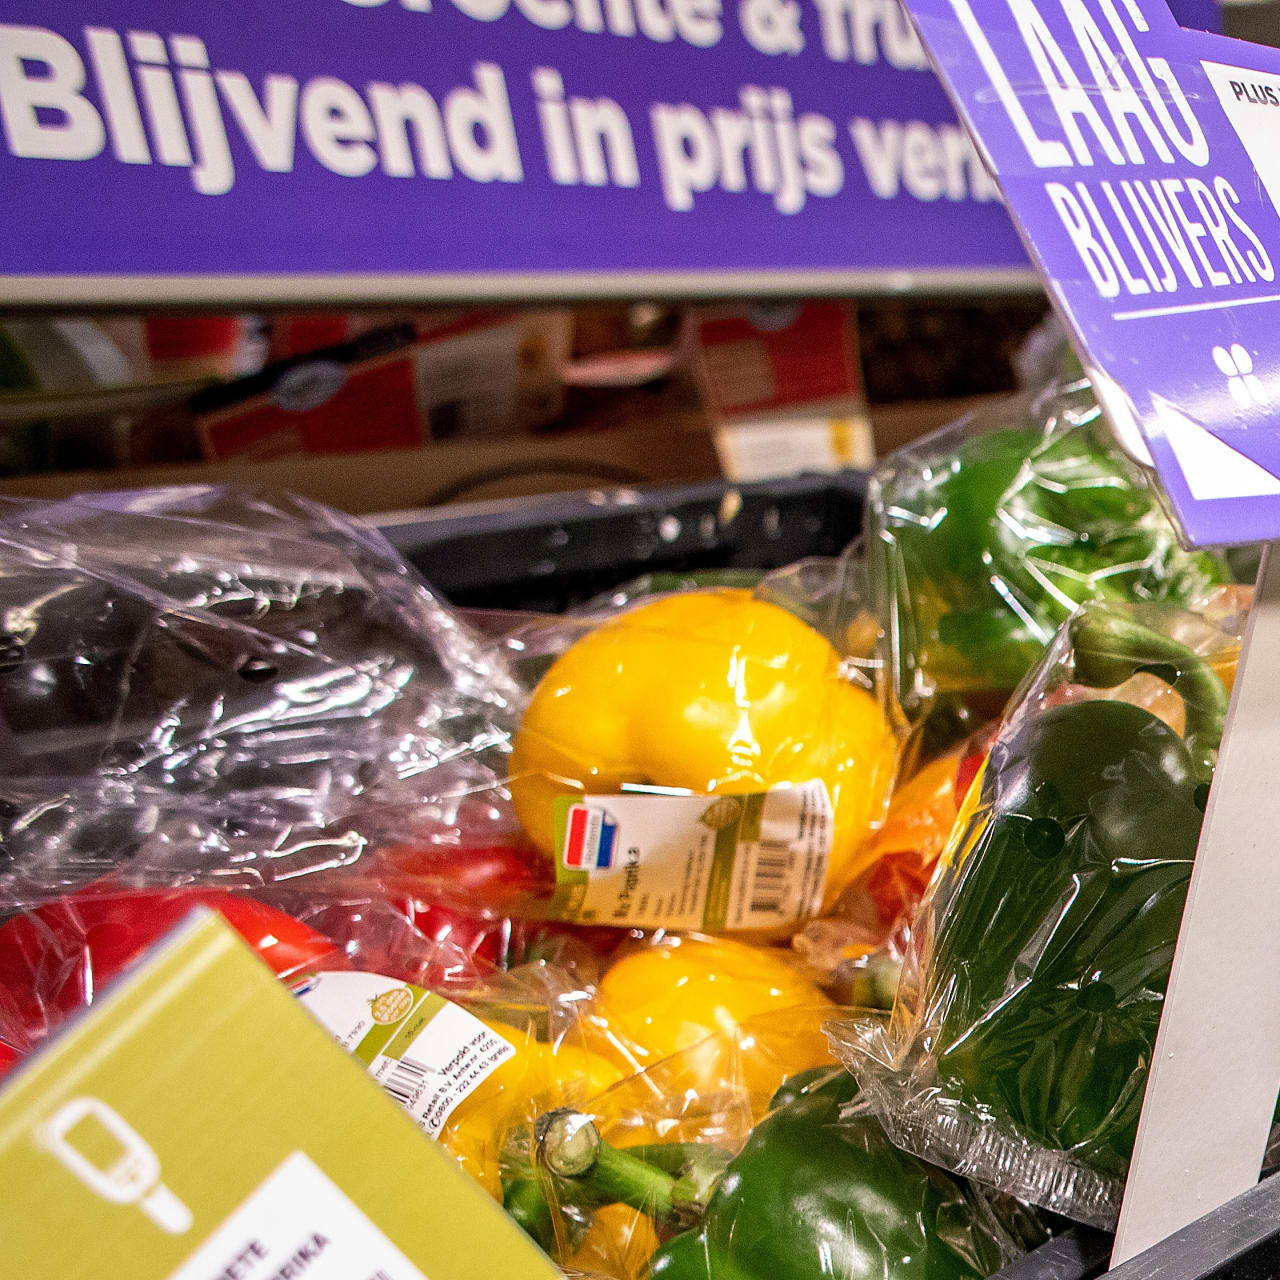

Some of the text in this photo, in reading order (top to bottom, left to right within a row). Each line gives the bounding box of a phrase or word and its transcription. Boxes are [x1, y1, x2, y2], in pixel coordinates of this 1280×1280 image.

[0, 23, 524, 196] Blijvend
[530, 66, 641, 189] in
[649, 86, 846, 216] prijs
[948, 0, 1210, 168] LAAG
[1229, 80, 1280, 108] PLUS
[1044, 175, 1276, 298] BLIJVERS
